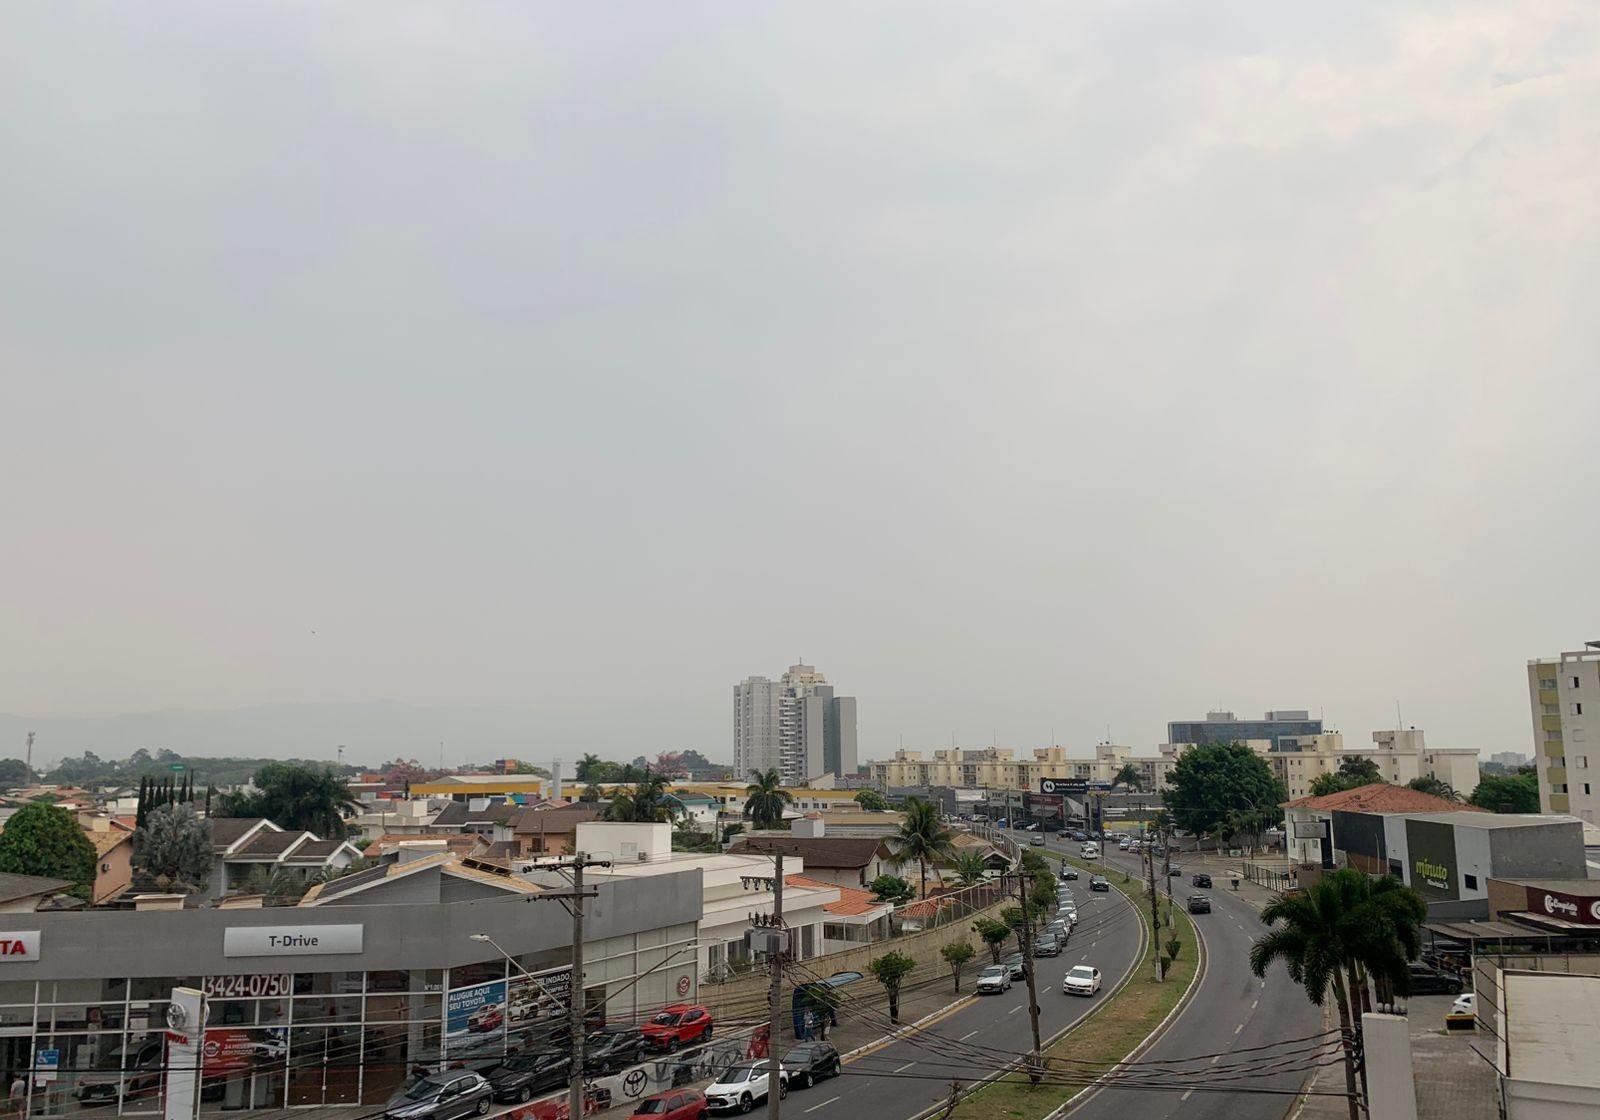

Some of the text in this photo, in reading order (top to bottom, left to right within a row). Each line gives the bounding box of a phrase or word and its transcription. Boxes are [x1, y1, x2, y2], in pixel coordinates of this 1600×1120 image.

[1416, 858, 1447, 880] minuto
[0, 940, 26, 955] TA
[268, 935, 319, 947] T-Drive
[207, 974, 290, 997] 3424-0750
[449, 986, 490, 1002] ALUGUE AQUI
[449, 996, 486, 1011] SEU TOYOTA
